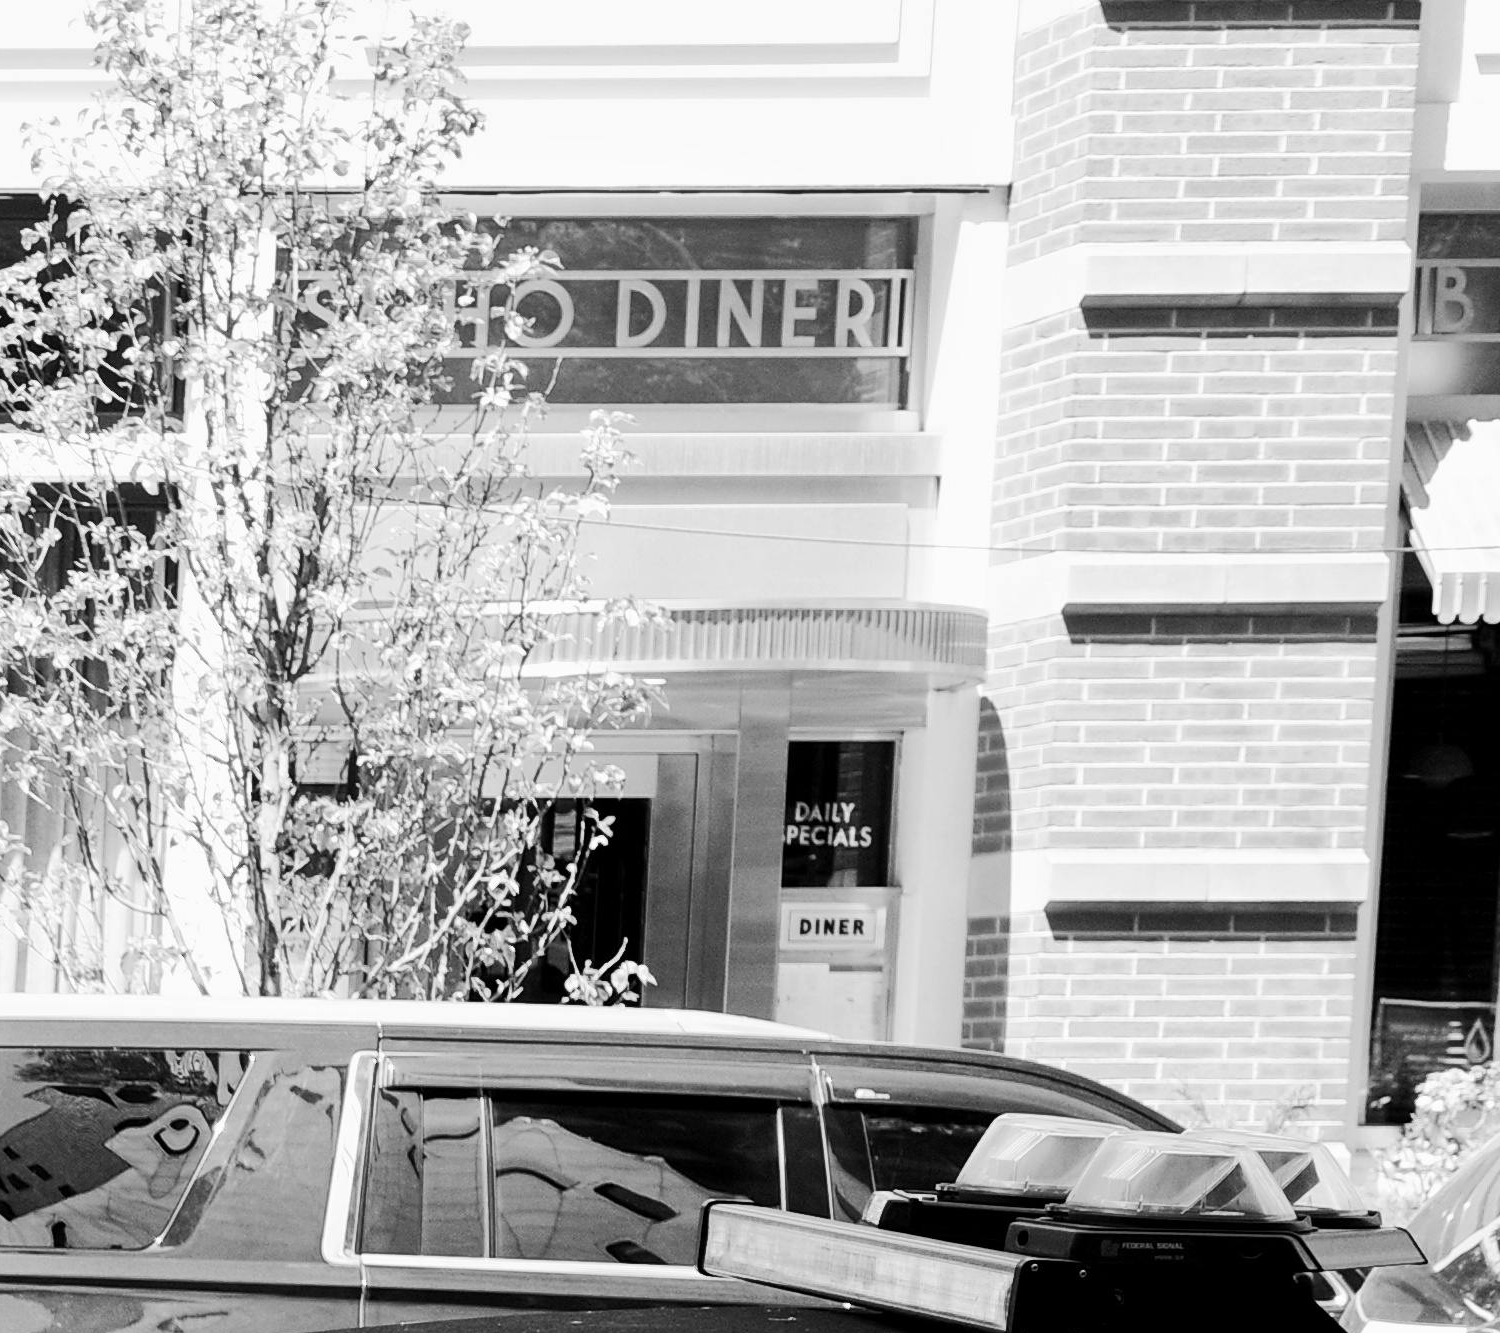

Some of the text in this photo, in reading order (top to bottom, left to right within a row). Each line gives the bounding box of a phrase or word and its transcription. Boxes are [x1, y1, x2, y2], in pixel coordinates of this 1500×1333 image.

[616, 278, 875, 348] DINER
[794, 801, 856, 823] DAILY
[784, 825, 873, 848] PECIALS
[799, 919, 865, 935] DINER
